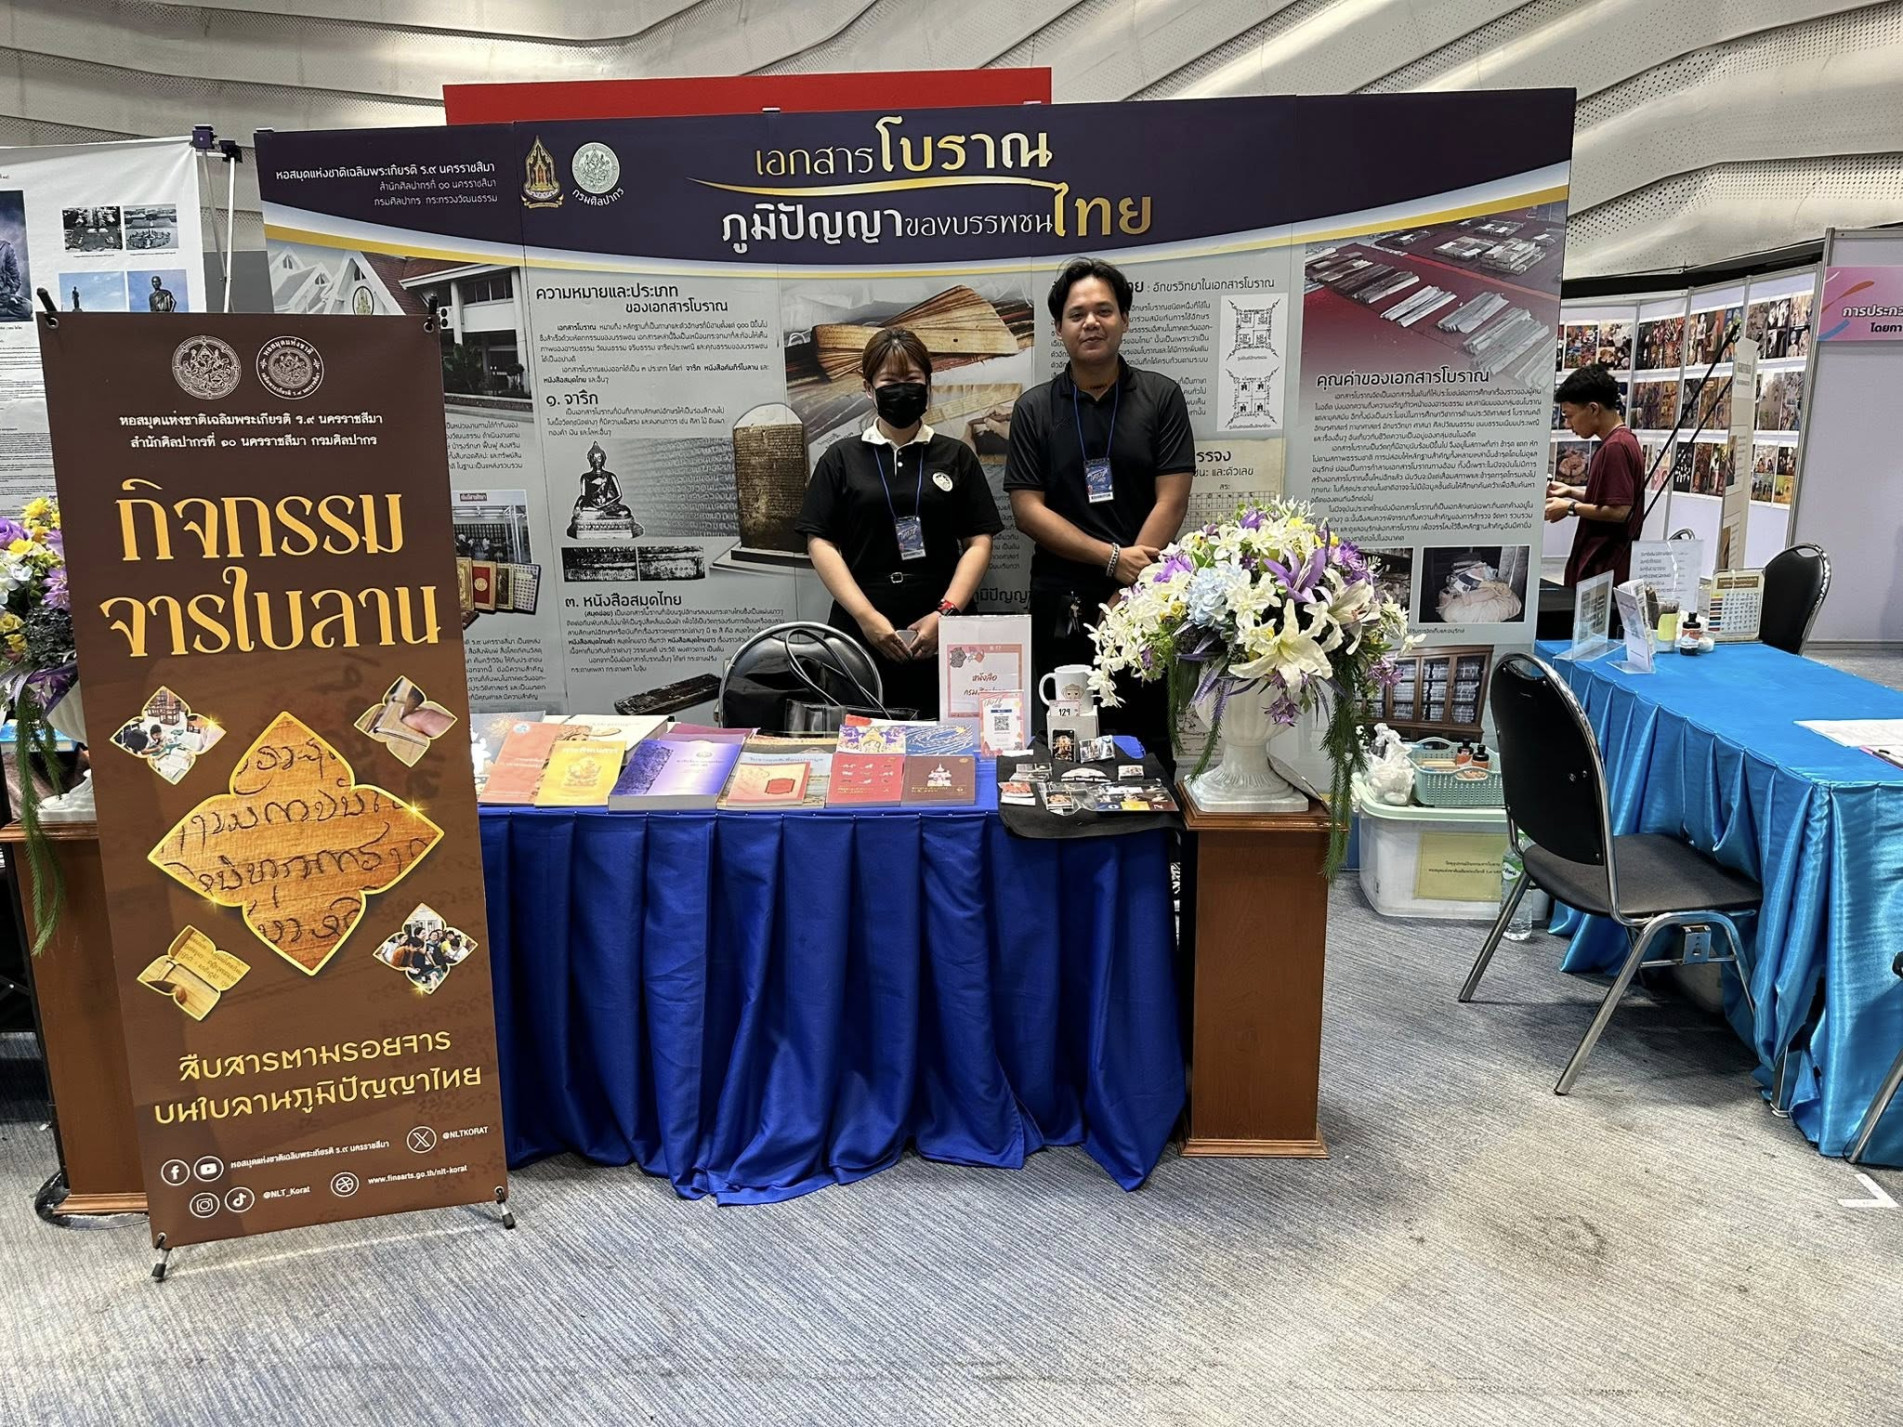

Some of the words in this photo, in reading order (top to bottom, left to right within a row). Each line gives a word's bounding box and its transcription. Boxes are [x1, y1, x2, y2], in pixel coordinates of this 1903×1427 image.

[756, 116, 1052, 176] เอกสารโบราณ
[276, 164, 418, 182] หอสมุดแห่งชาติเฉลิมพระเกียรติ
[439, 161, 495, 174] นครราชสีมา
[572, 188, 624, 206] กรมศิลปากร
[722, 182, 1152, 253] ภูมิปัญญาของบรรพชนไทย
[536, 283, 679, 300] ความหมายและประเภท
[626, 298, 728, 313] ของเอกสารโบราณ
[1316, 366, 1490, 391] คุณค่าของเอกสารโบราณ
[564, 389, 599, 406] จารึก
[119, 410, 291, 429] หอสมุดแห่งชาติเฉลิมพระเกียรติ
[296, 414, 315, 425] ร.๙
[319, 411, 383, 425] นครราชสีมา
[130, 432, 216, 448] สำนักศิลปากรที่
[221, 439, 236, 447] ๑๐
[241, 434, 306, 447] นครราชสีมา
[311, 434, 377, 447] กรมศิลปากร
[115, 478, 404, 561] กิจกรรม
[583, 591, 682, 610] หนังสือสมุดไทย
[100, 566, 441, 657] จารใบลาน
[1059, 709, 1071, 717] 129
[179, 1030, 452, 1081] สืบสารตามรอยจาร
[155, 1066, 482, 1124] บนใบลานภูมิปัญญาไทย
[442, 1126, 488, 1140] @NLTKORAT
[263, 1186, 310, 1200] @NLT_Korat
